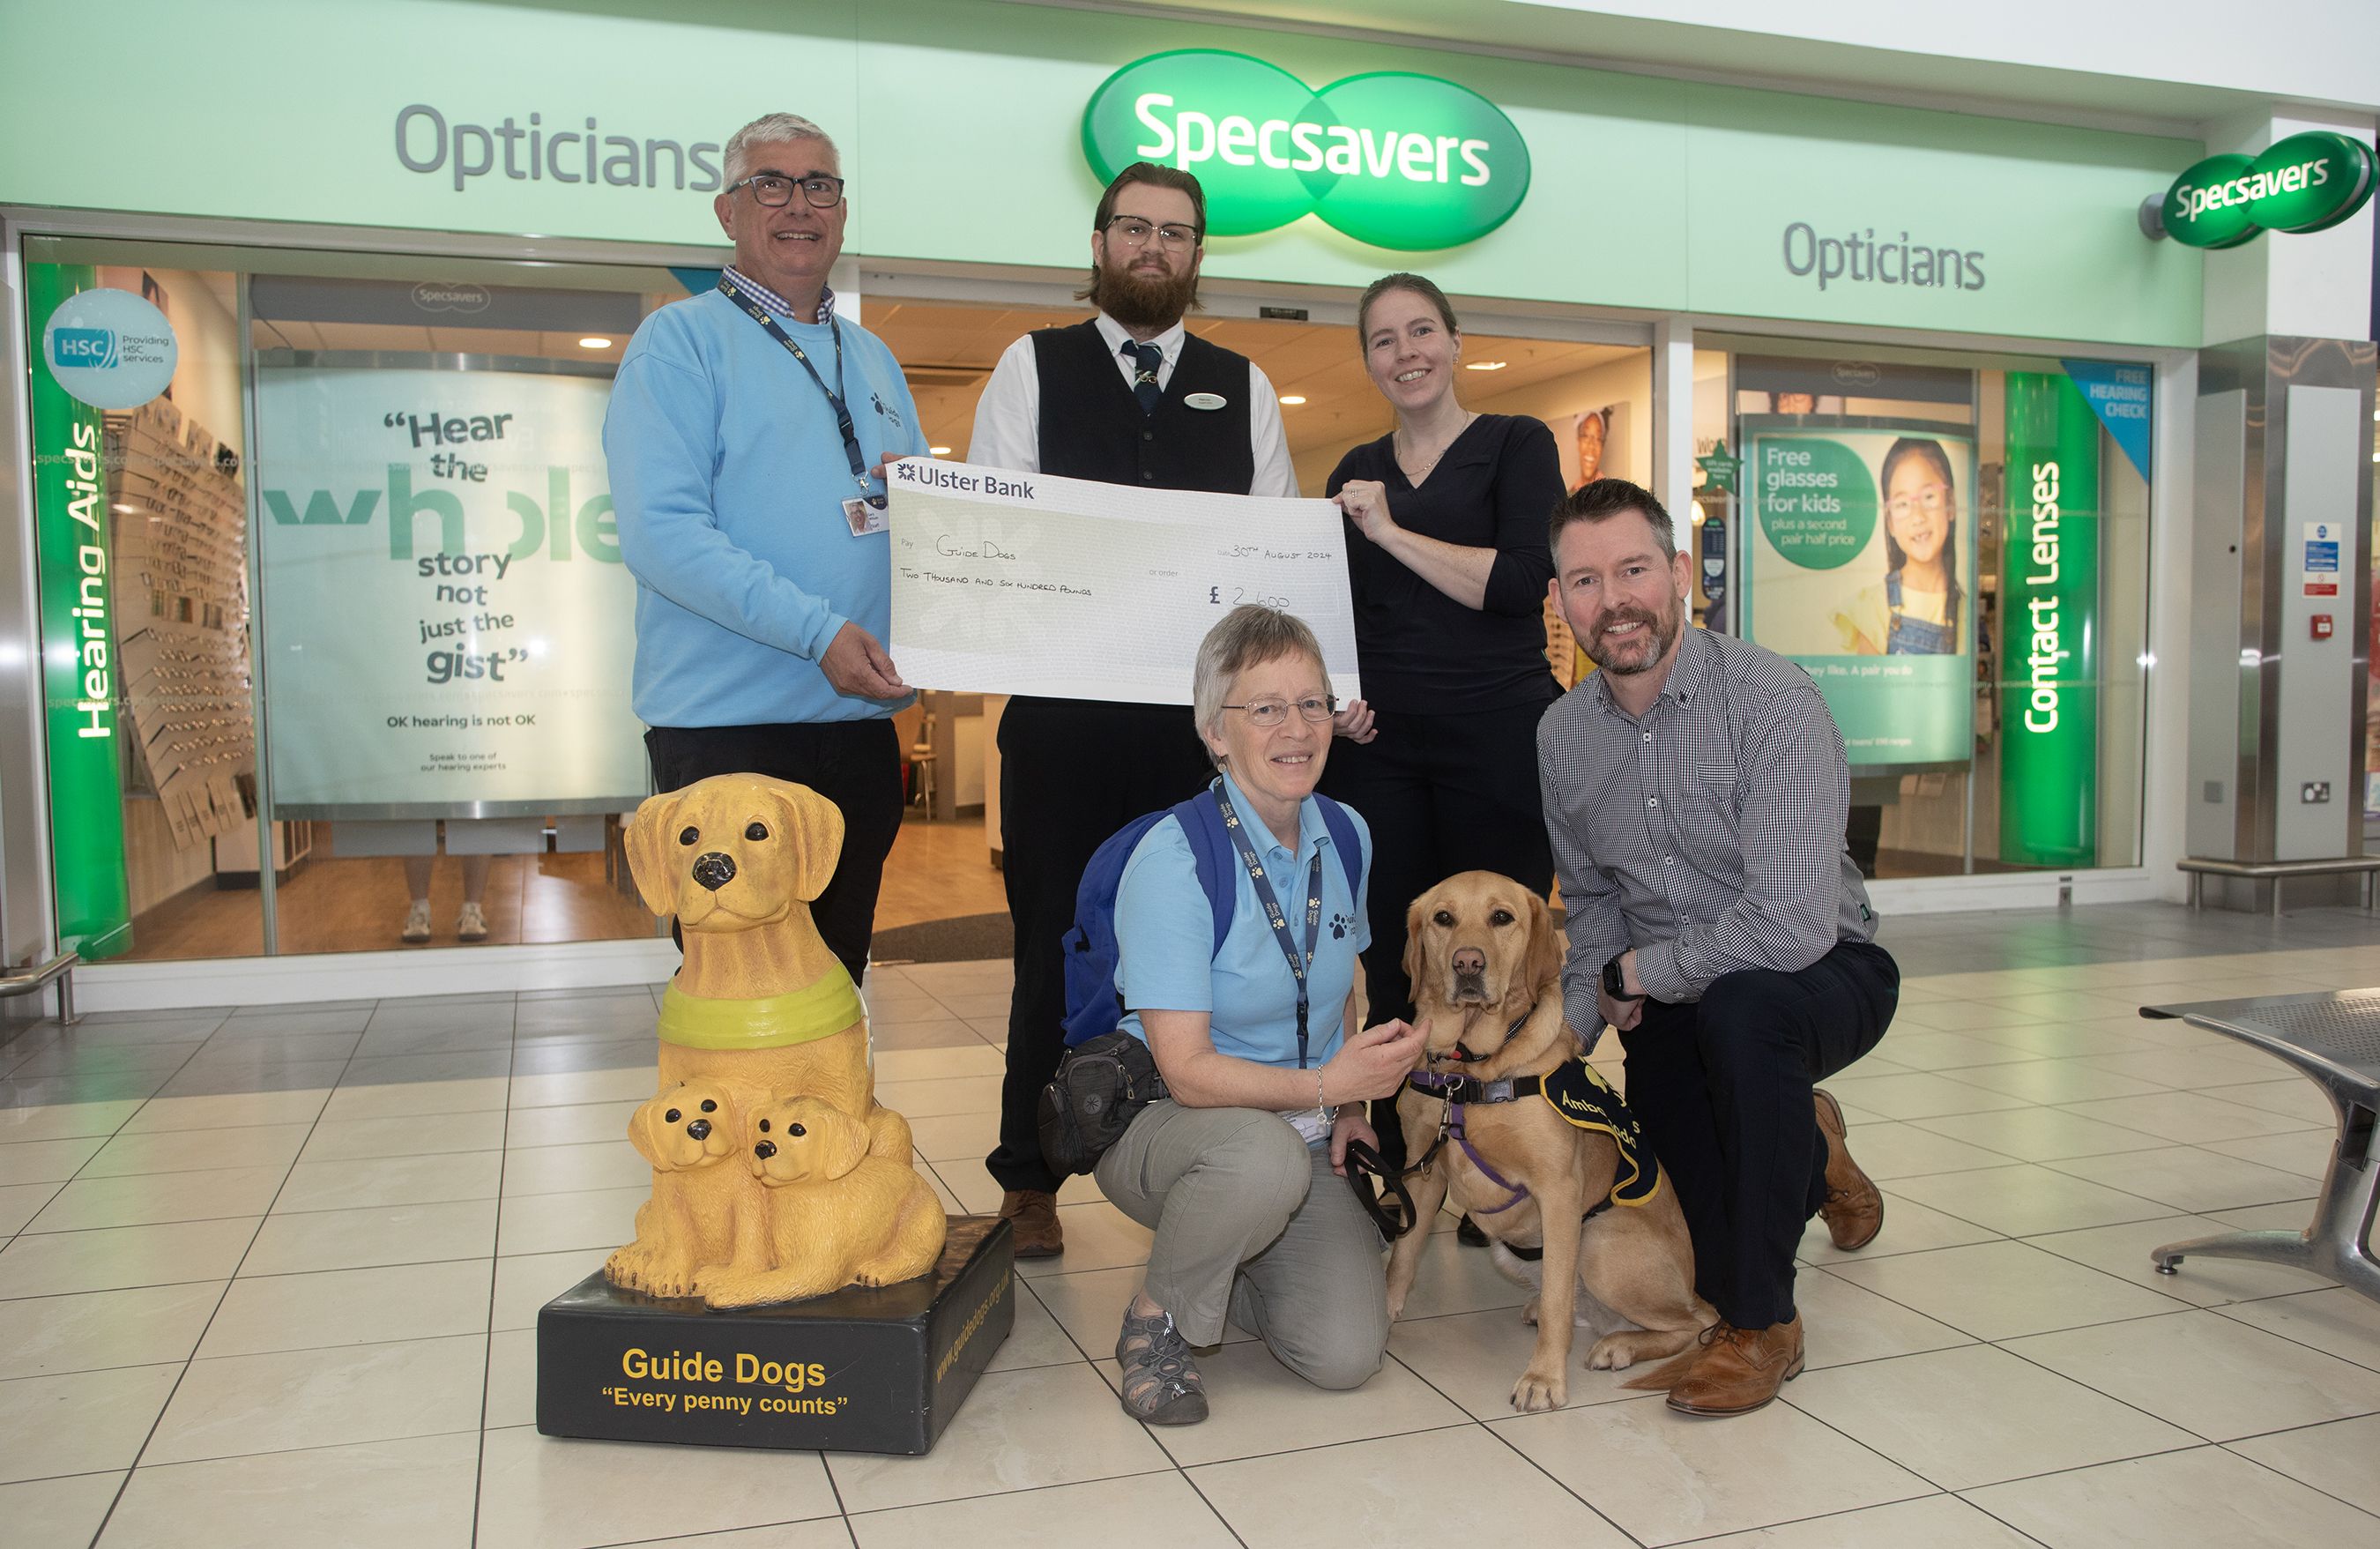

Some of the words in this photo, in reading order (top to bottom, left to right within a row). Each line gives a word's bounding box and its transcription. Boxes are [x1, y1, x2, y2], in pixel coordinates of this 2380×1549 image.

[395, 104, 723, 192] Opticians
[1134, 93, 1491, 187] Specsavers
[2175, 158, 2329, 222] Specsavers
[1783, 222, 1986, 291] Opticians
[420, 289, 483, 303] Specsavers
[62, 339, 104, 357] HSC
[123, 335, 169, 346] Providing
[123, 345, 144, 354] HSC
[123, 354, 164, 363] services
[2116, 369, 2147, 384] FREE
[2089, 384, 2147, 401] HEARING
[2105, 402, 2147, 419] CHECK
[1766, 448, 1811, 466] Free
[64, 422, 100, 532] Aids
[430, 453, 488, 482] the
[919, 465, 979, 492] Ulster
[985, 476, 1035, 500] Bank
[1766, 468, 1838, 492] glasses
[1767, 492, 1798, 512] for
[1801, 493, 1841, 512] kids
[1771, 518, 1795, 532] plus
[1797, 520, 1805, 529] a
[1807, 518, 1847, 530] second
[2026, 462, 2060, 585] Lenses
[901, 538, 914, 548] Pay
[1781, 532, 1804, 546] pair
[1805, 532, 1827, 545] half
[1828, 534, 1856, 547] price
[418, 552, 513, 580] story
[436, 585, 487, 606] not
[1209, 586, 1221, 605] £
[420, 618, 466, 644] just
[473, 613, 514, 631] the
[71, 545, 111, 739] Hearing
[2024, 595, 2059, 734] Contact
[387, 716, 408, 728] OK
[413, 714, 468, 729] hearing
[472, 714, 483, 726] is
[487, 715, 511, 726] not
[515, 714, 536, 726] OK
[429, 753, 455, 763] Speak
[438, 763, 471, 772] hearing
[473, 763, 506, 772] experts
[936, 1268, 1010, 1383] www.guidedogs.org.uk
[621, 1348, 723, 1382] Guide
[735, 1352, 826, 1393] Dogs
[683, 1393, 752, 1416] penny
